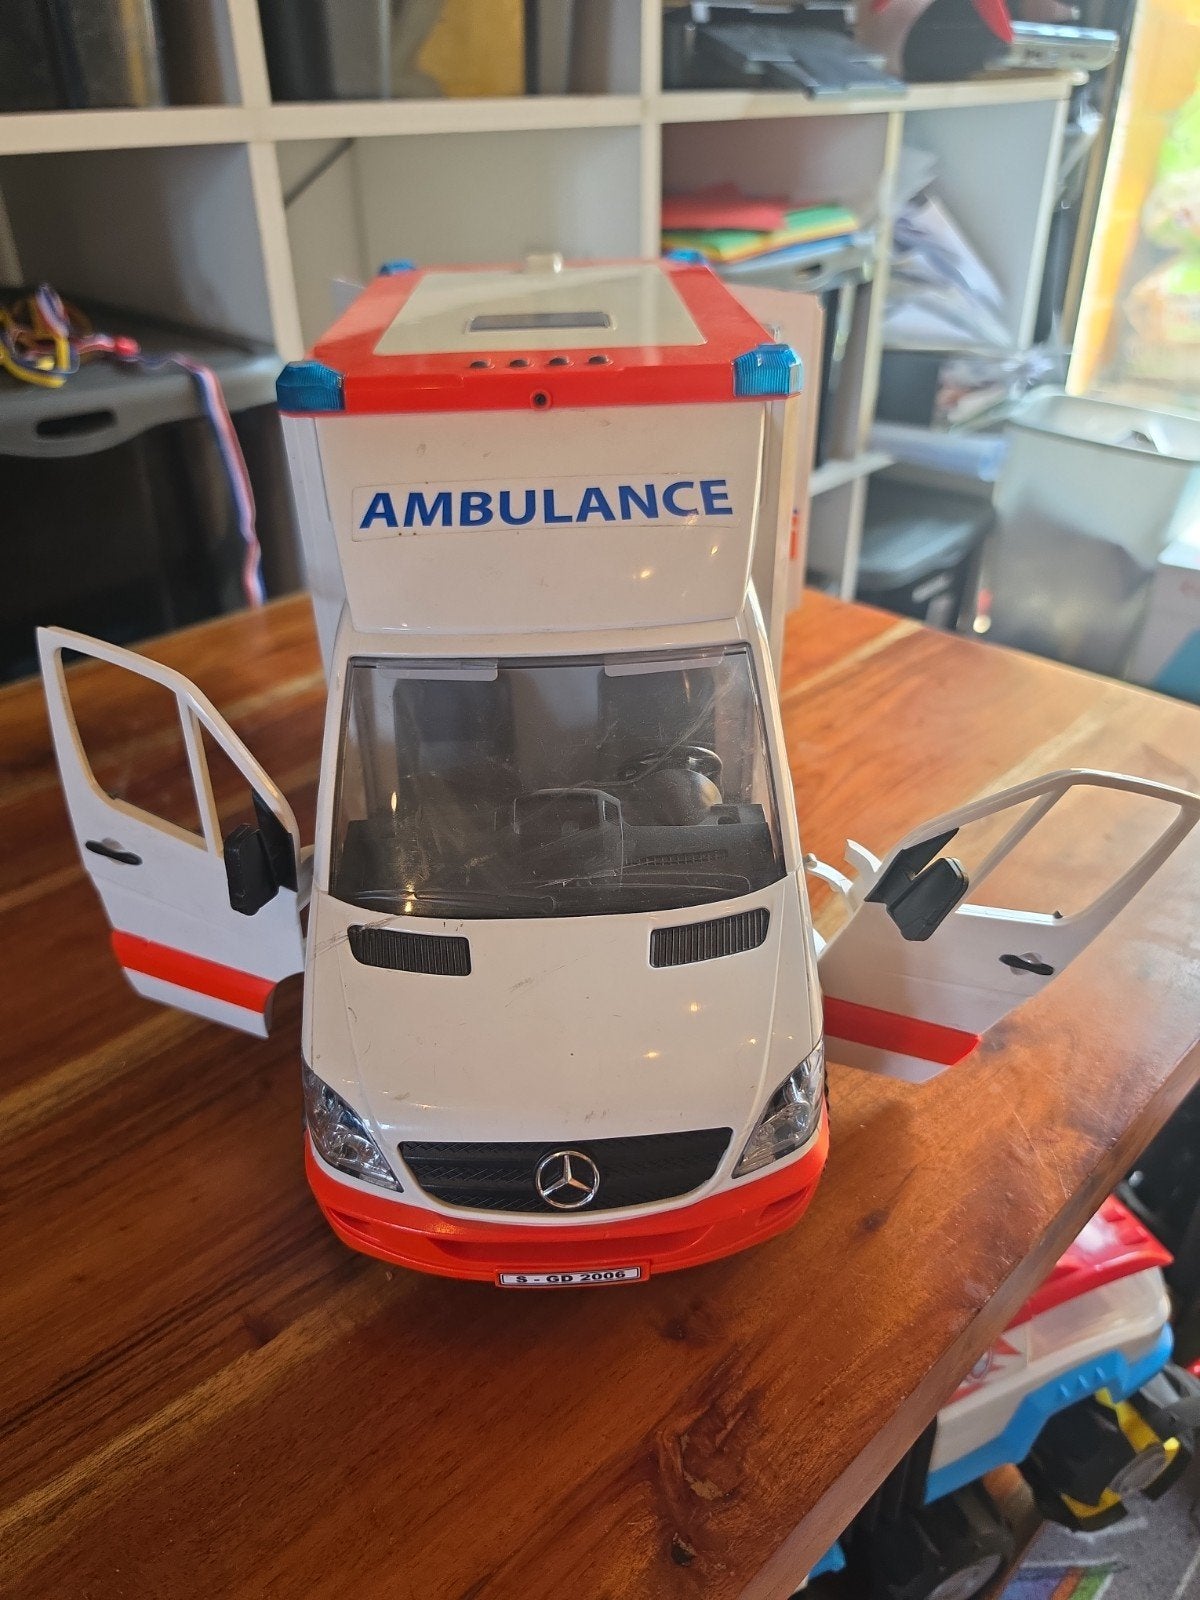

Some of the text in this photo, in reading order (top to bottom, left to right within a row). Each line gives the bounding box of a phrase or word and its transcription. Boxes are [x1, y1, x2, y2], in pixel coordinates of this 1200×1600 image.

[359, 479, 733, 529] AMBULANCE
[516, 1275, 528, 1283] S
[546, 1275, 573, 1283] GD
[580, 1271, 626, 1281] 2006
